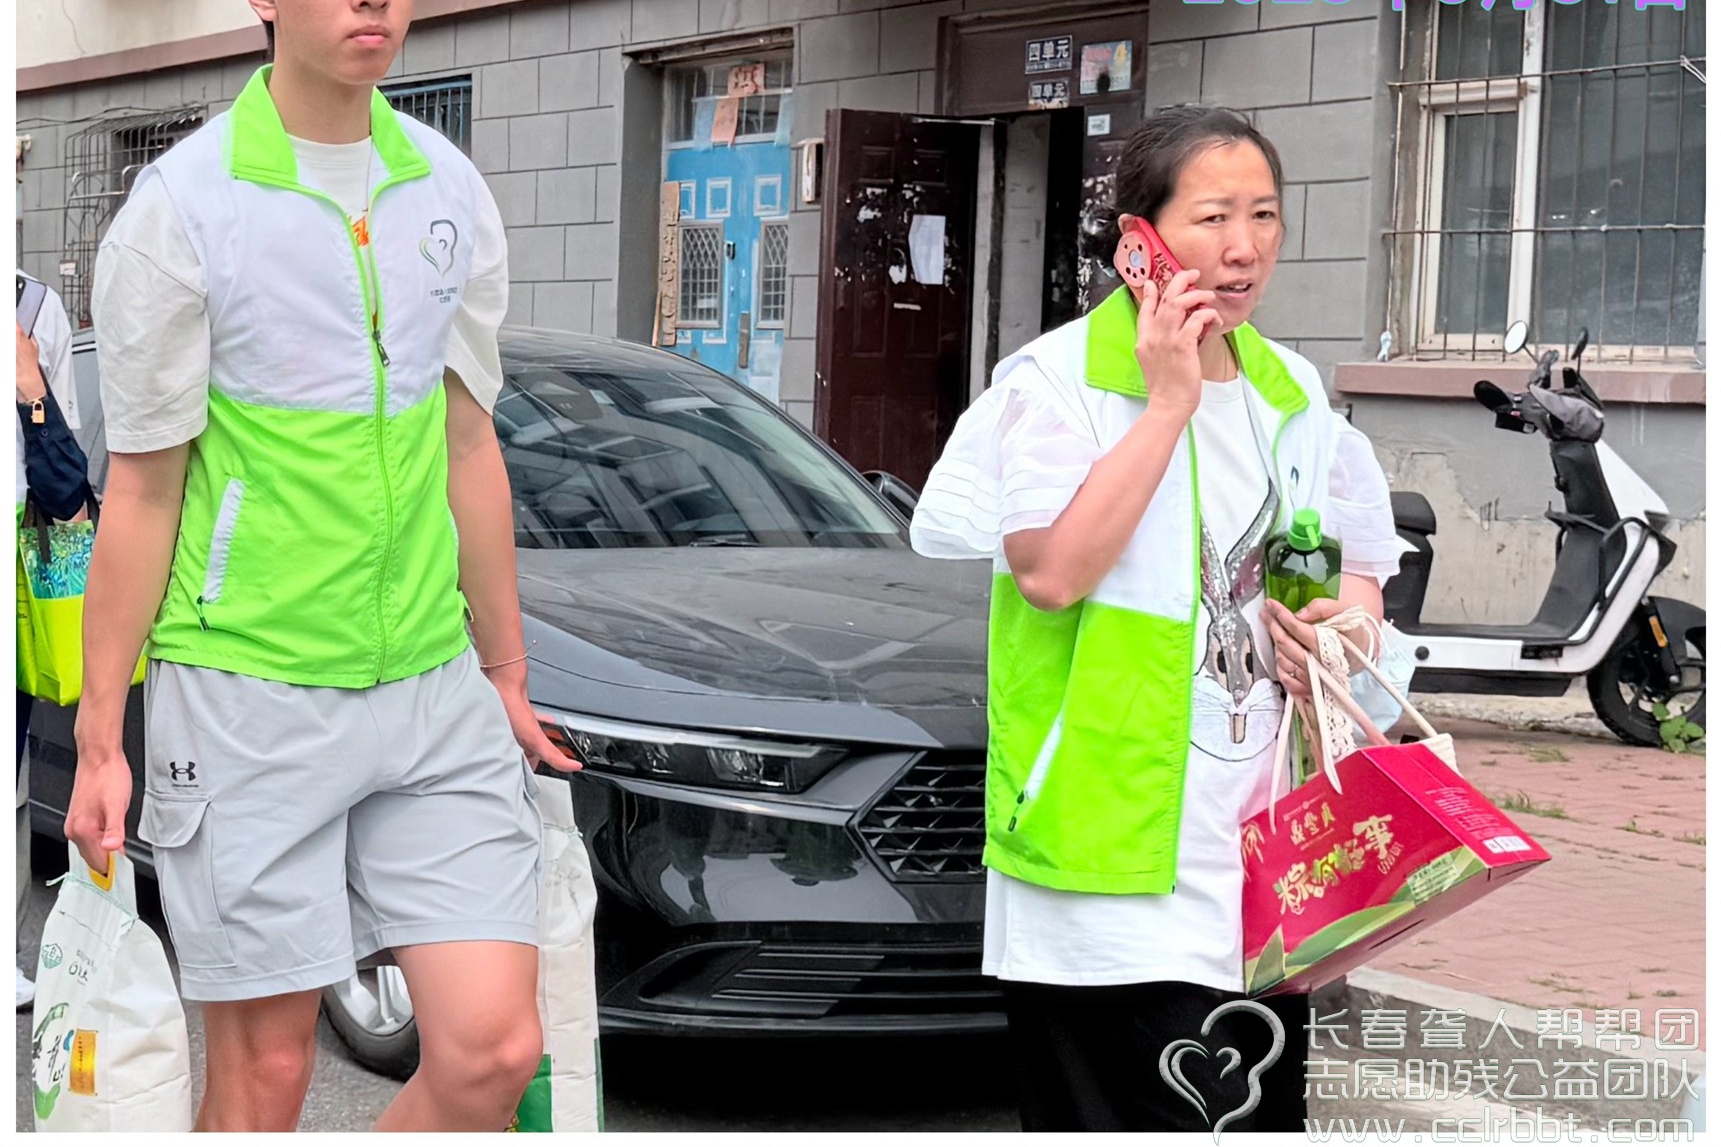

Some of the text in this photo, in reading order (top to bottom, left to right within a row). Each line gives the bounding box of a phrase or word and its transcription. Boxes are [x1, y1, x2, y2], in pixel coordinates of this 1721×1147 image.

[1028, 39, 1069, 61] 四单元
[1031, 82, 1066, 98] 四单元
